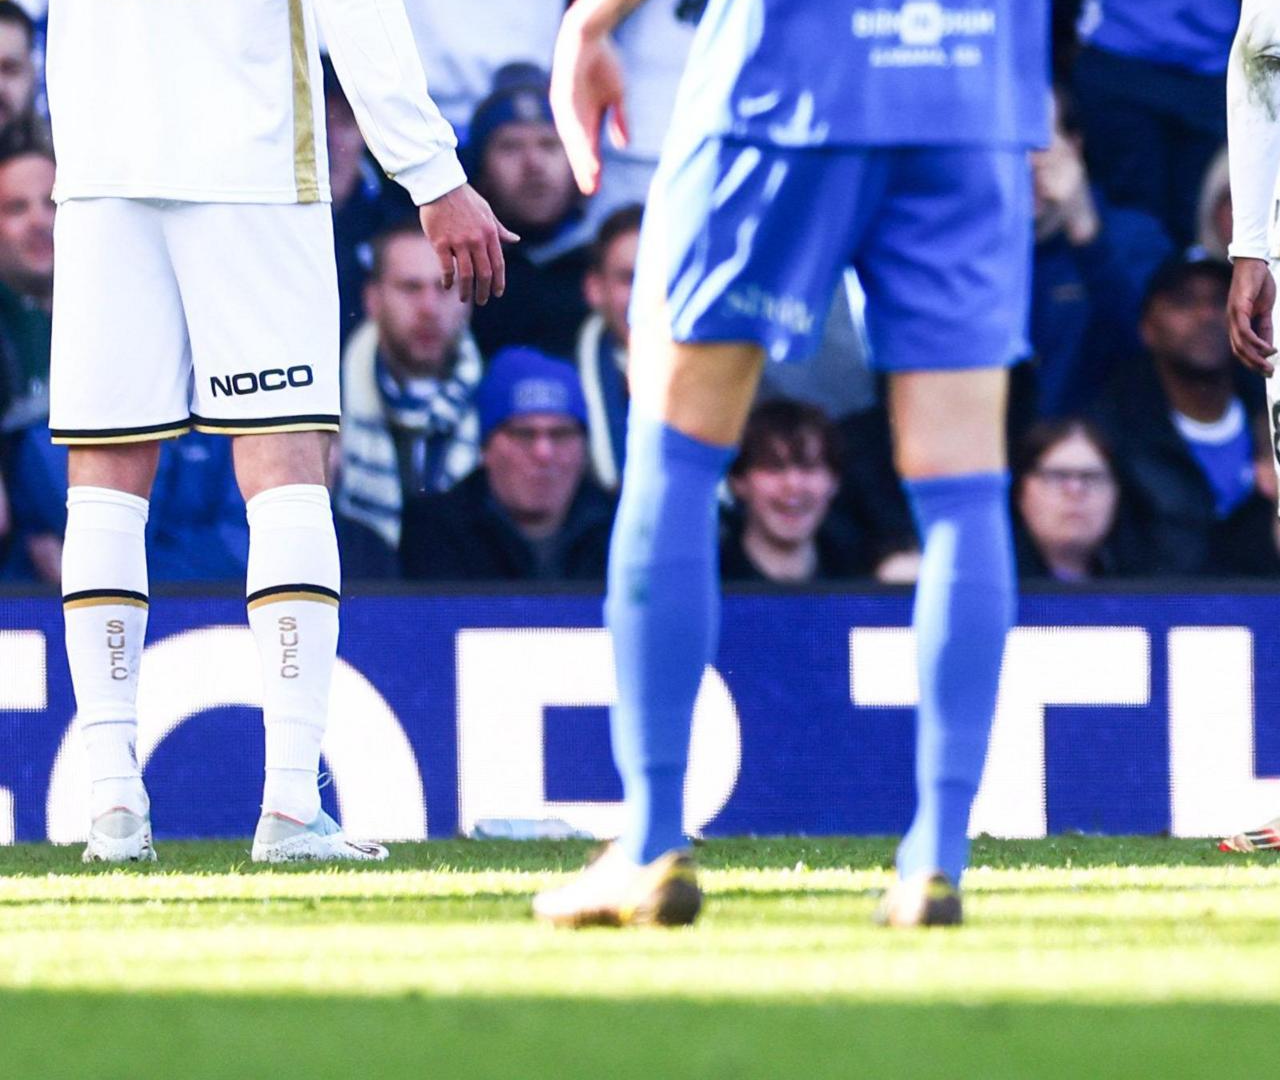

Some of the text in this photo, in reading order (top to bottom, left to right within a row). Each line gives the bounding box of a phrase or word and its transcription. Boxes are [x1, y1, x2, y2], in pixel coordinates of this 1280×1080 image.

[210, 364, 314, 397] NOCO
[106, 620, 128, 681] SUFC
[278, 616, 299, 679] SUFC
